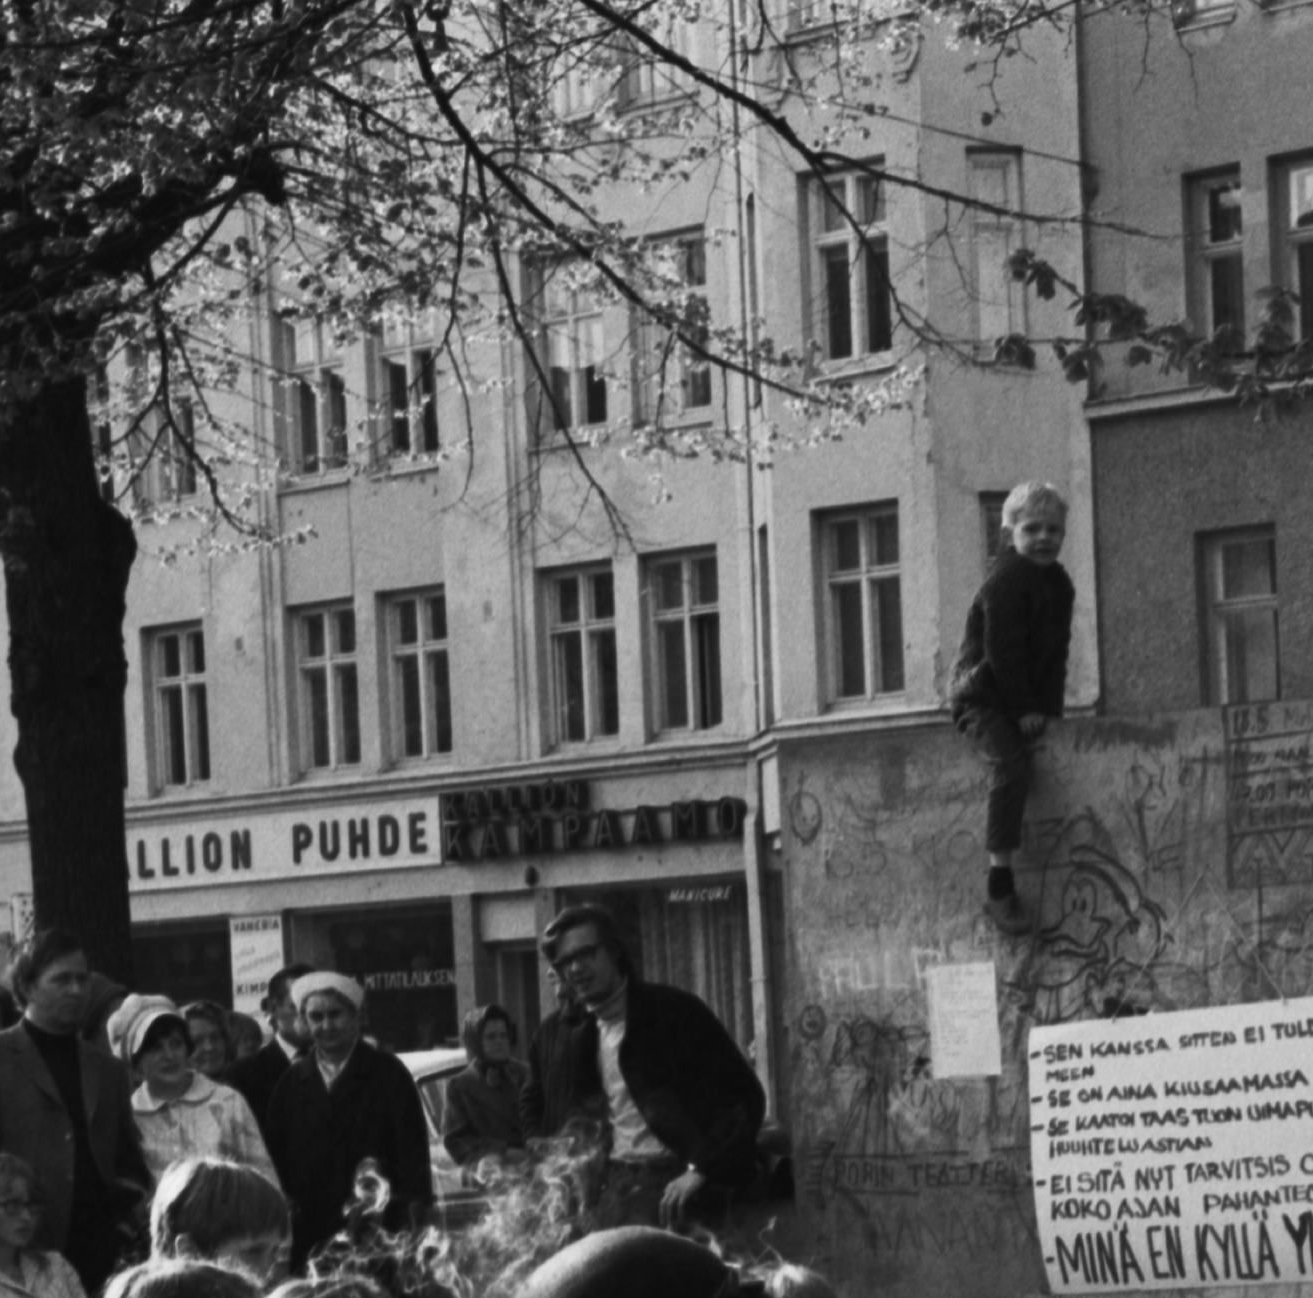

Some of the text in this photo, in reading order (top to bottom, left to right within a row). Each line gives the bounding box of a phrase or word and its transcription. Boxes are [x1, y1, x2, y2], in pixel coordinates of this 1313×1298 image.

[444, 781, 583, 820] KALLION
[446, 797, 743, 857] KAMPAAMO
[126, 811, 429, 880] LLION PUHDE
[667, 885, 732, 904] MANICURE
[237, 982, 268, 996] KIMP
[1090, 1040, 1170, 1058] KANSSA
[1244, 1028, 1264, 1043] EI
[1046, 1065, 1094, 1082] MEEN
[1078, 1088, 1103, 1103] ON
[1107, 1083, 1157, 1101] AINA
[1165, 1070, 1309, 1097] KIUSAAMASSA
[1076, 1113, 1135, 1131] KAATOI
[1141, 1108, 1189, 1126] TAAS
[1192, 1107, 1242, 1124] TUON
[834, 1160, 894, 1187] PORIN
[1077, 1162, 1125, 1192] SITÄ
[1135, 1165, 1175, 1192] NYT
[1185, 1155, 1291, 1182] TARVITSIS
[1051, 1200, 1111, 1221] KOKO
[1116, 1197, 1180, 1219] AJAN
[1147, 1225, 1186, 1279] EN
[1195, 1210, 1280, 1281] KYLLÄ
